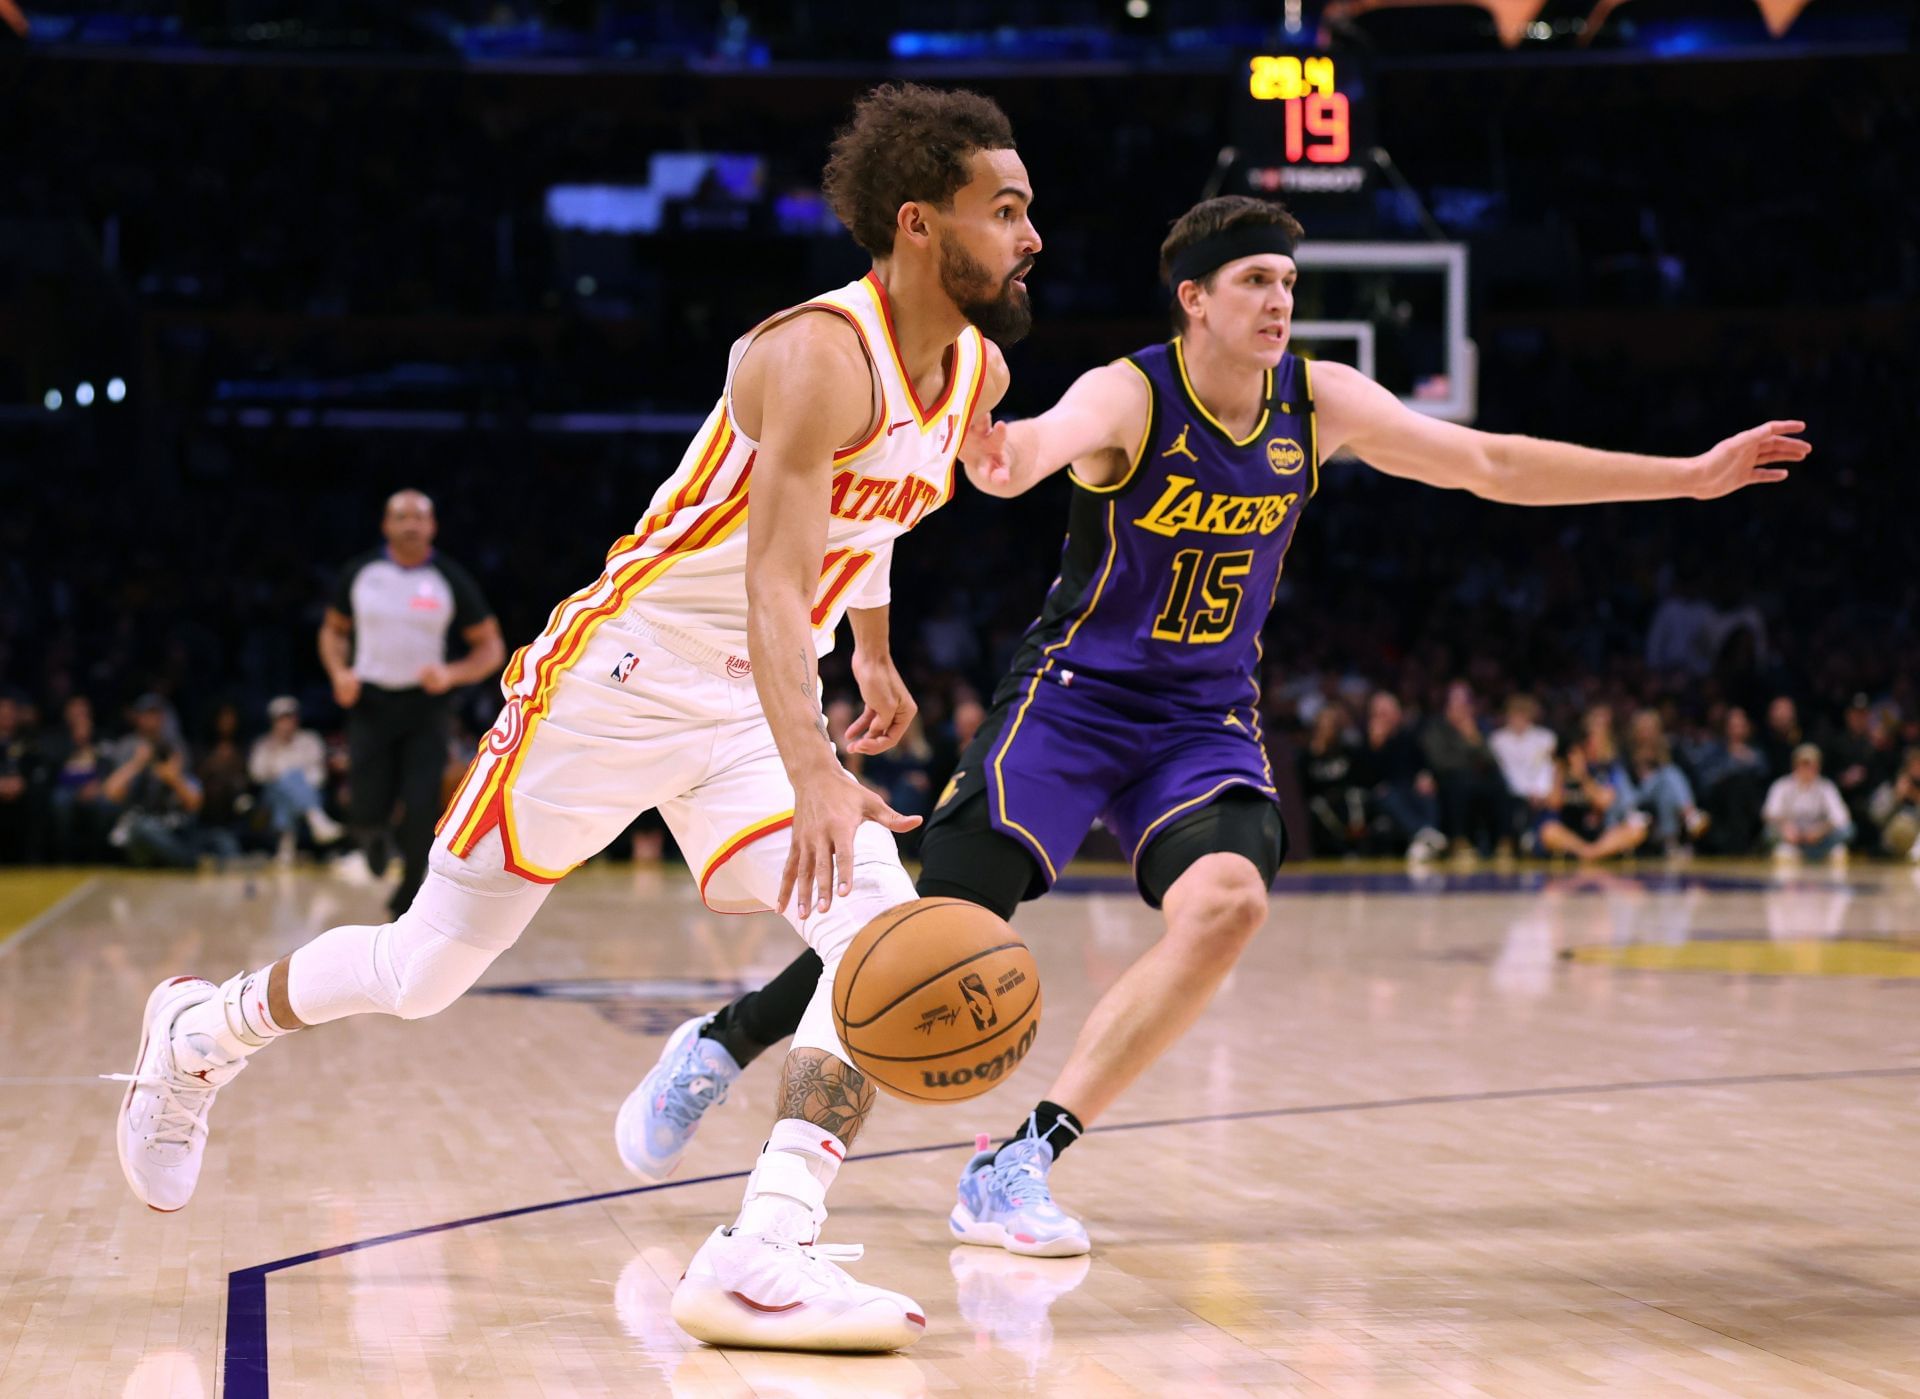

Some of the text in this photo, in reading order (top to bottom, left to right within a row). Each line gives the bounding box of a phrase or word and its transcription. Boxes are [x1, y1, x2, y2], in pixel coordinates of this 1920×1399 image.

[1285, 93, 1349, 163] 19
[1133, 474, 1298, 537] LAKERS
[1151, 549, 1254, 643] 15
[724, 655, 753, 673] HAWK
